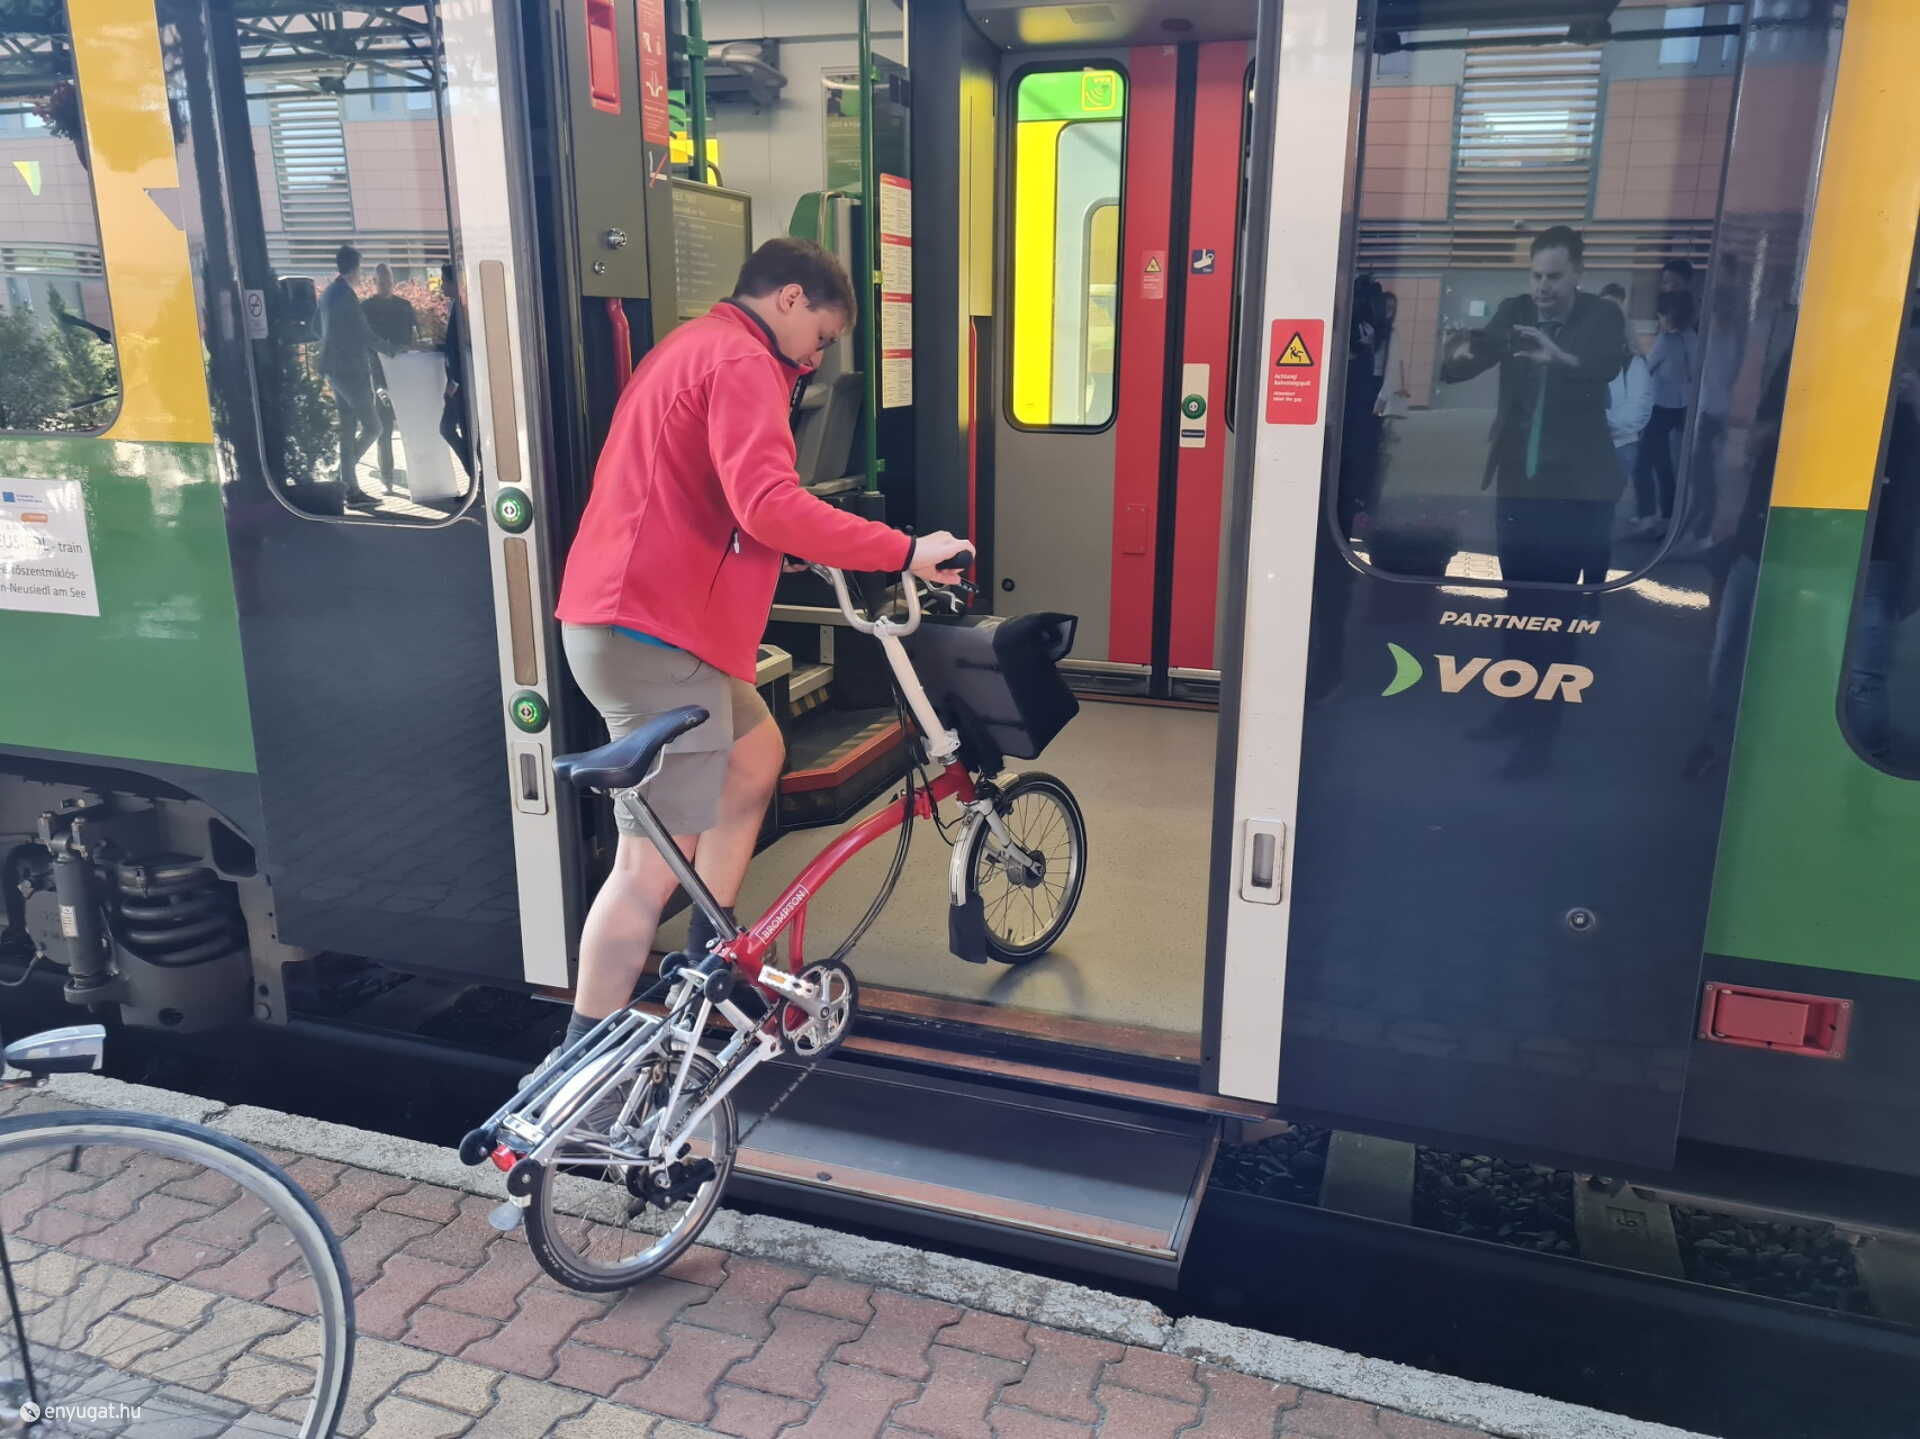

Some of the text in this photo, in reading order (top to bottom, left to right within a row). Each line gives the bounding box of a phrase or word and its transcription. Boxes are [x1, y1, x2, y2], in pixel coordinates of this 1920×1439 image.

[57, 542, 83, 553] train
[53, 588, 68, 597] am
[70, 587, 87, 599] See
[1439, 610, 1601, 635] PARTNER IM
[1433, 653, 1595, 704] VOR
[761, 889, 806, 938] BROMPTON
